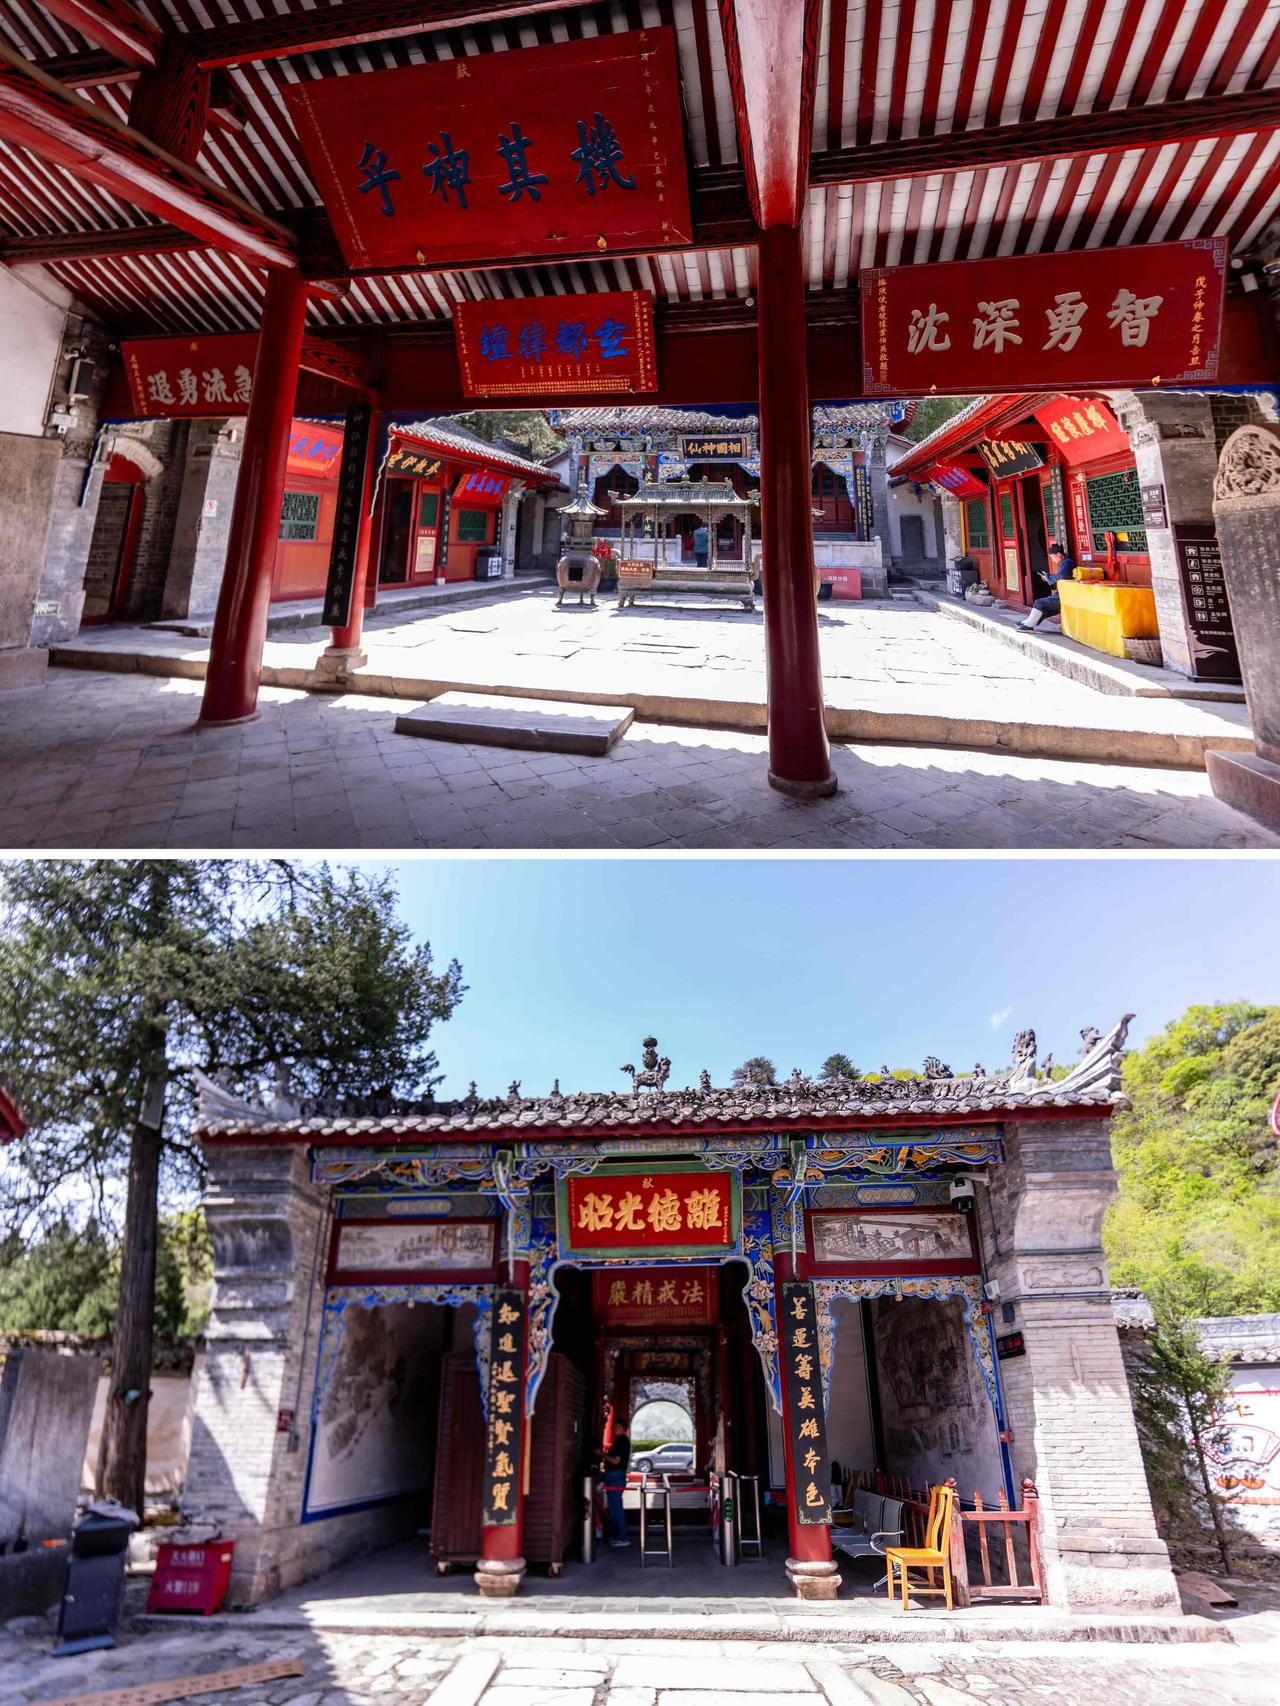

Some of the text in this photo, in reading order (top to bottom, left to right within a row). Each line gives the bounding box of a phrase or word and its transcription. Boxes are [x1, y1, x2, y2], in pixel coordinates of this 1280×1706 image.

[357, 111, 637, 217] 機其神乎
[479, 318, 629, 363] 玄都律壇
[906, 288, 1164, 355] 智勇深沈
[147, 363, 254, 406] 急流勇退
[687, 441, 741, 456] 相國神仙
[607, 1279, 706, 1306] 法戒精嚴
[790, 1296, 825, 1508] 善運籌英雄本色
